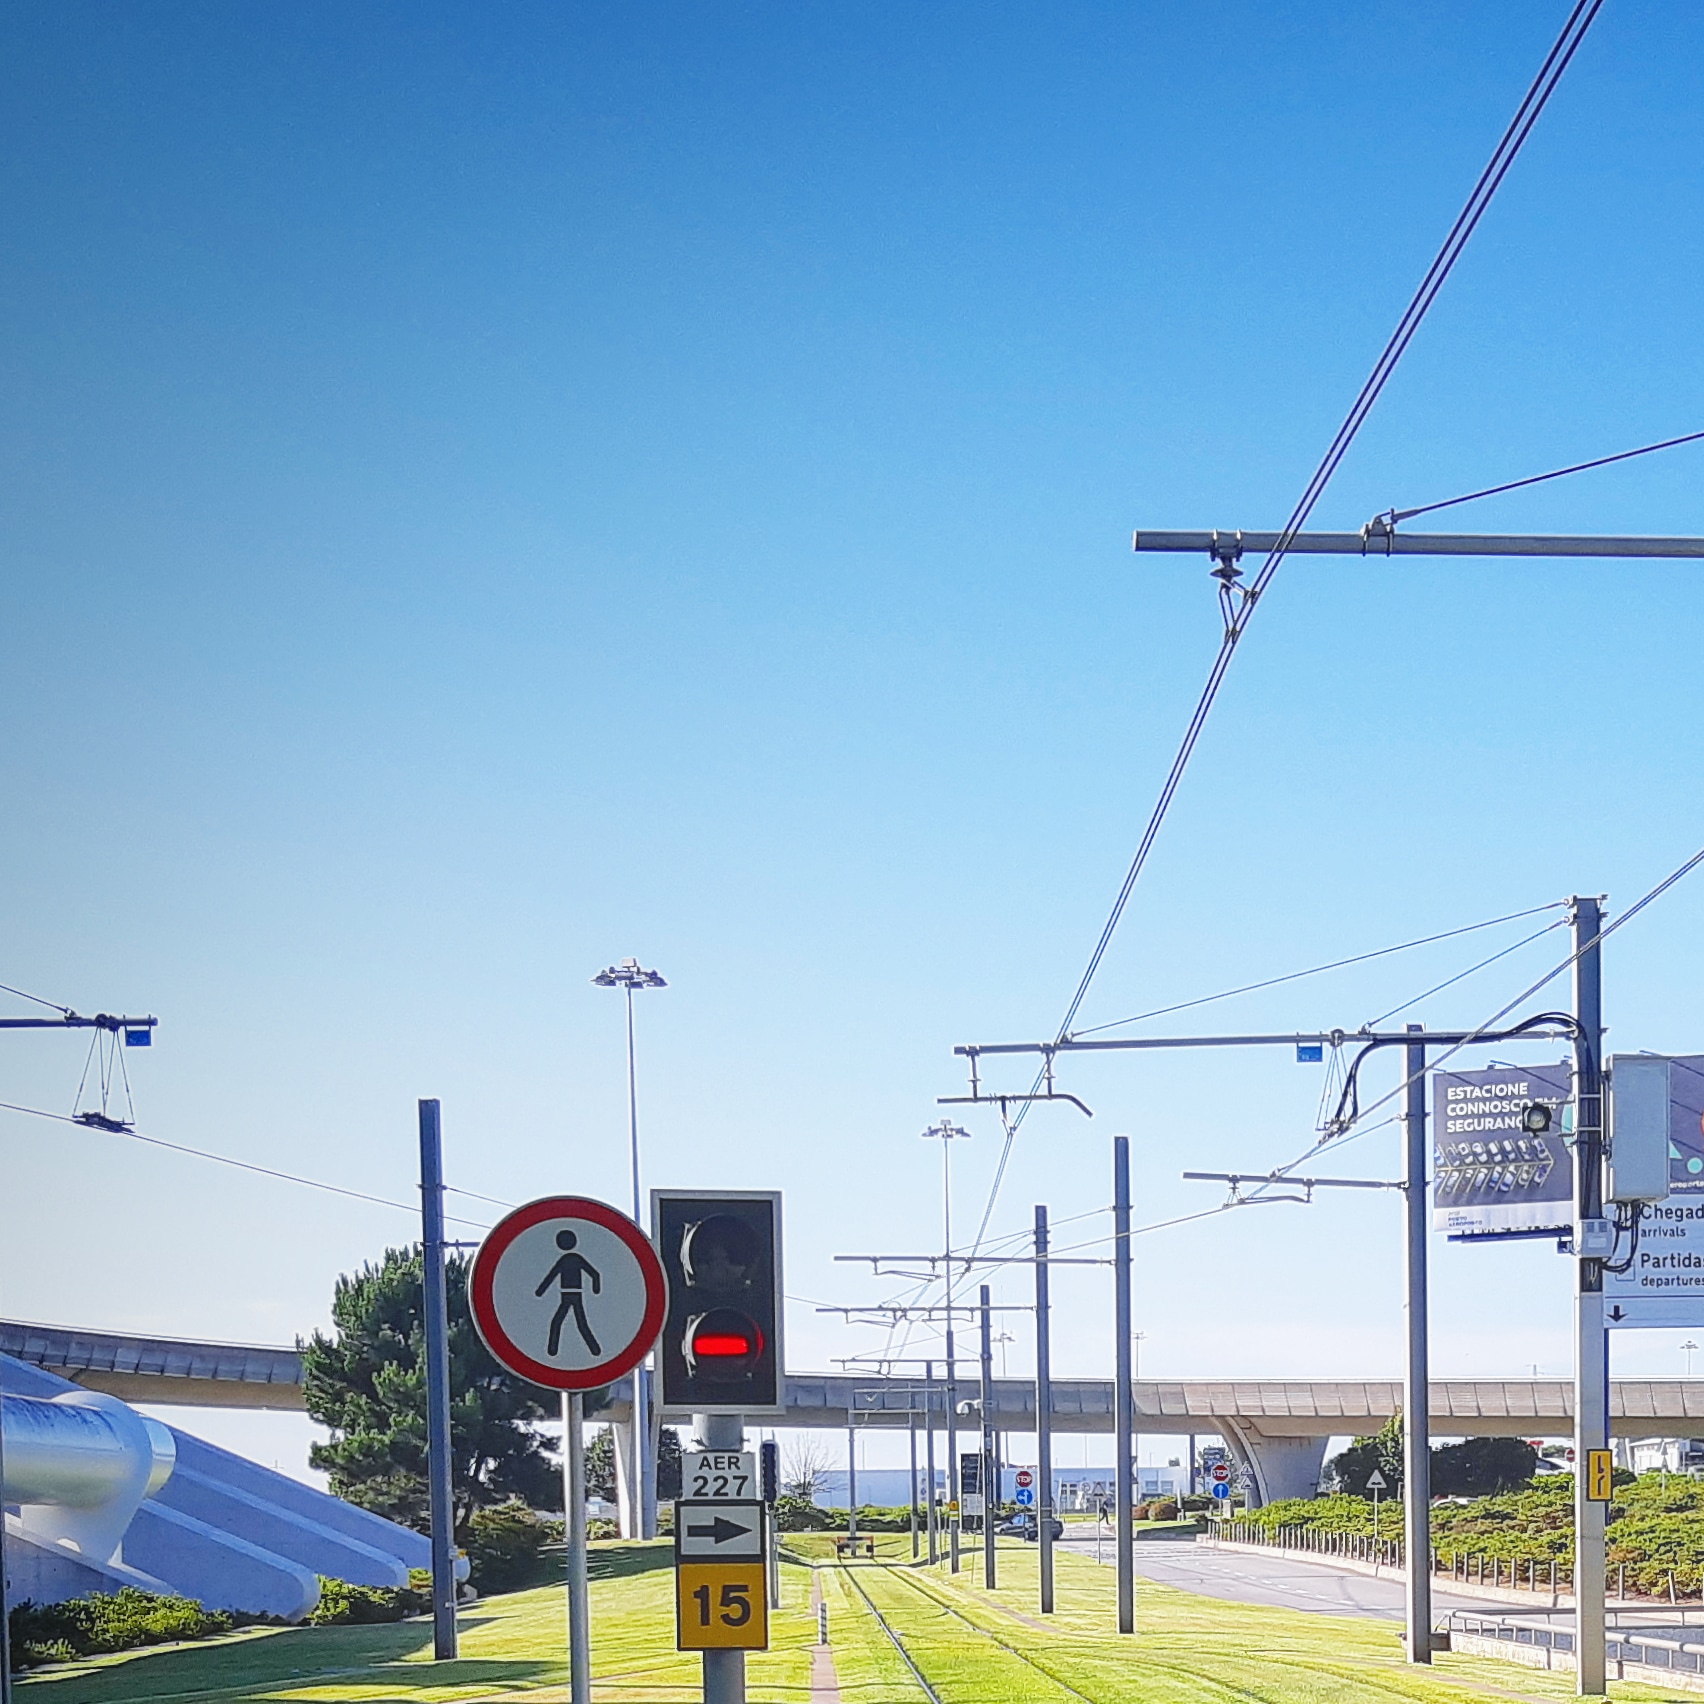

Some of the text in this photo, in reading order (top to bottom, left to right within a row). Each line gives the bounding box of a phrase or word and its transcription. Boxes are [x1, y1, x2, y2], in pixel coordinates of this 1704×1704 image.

[1447, 1082, 1529, 1100] ESTACIONE
[1446, 1099, 1532, 1116] CONNOSCO
[1446, 1116, 1523, 1133] SEGURAN
[1640, 1226, 1687, 1238] arrivals
[699, 1455, 741, 1471] AER
[693, 1475, 749, 1497] 227
[693, 1584, 752, 1628] 15
